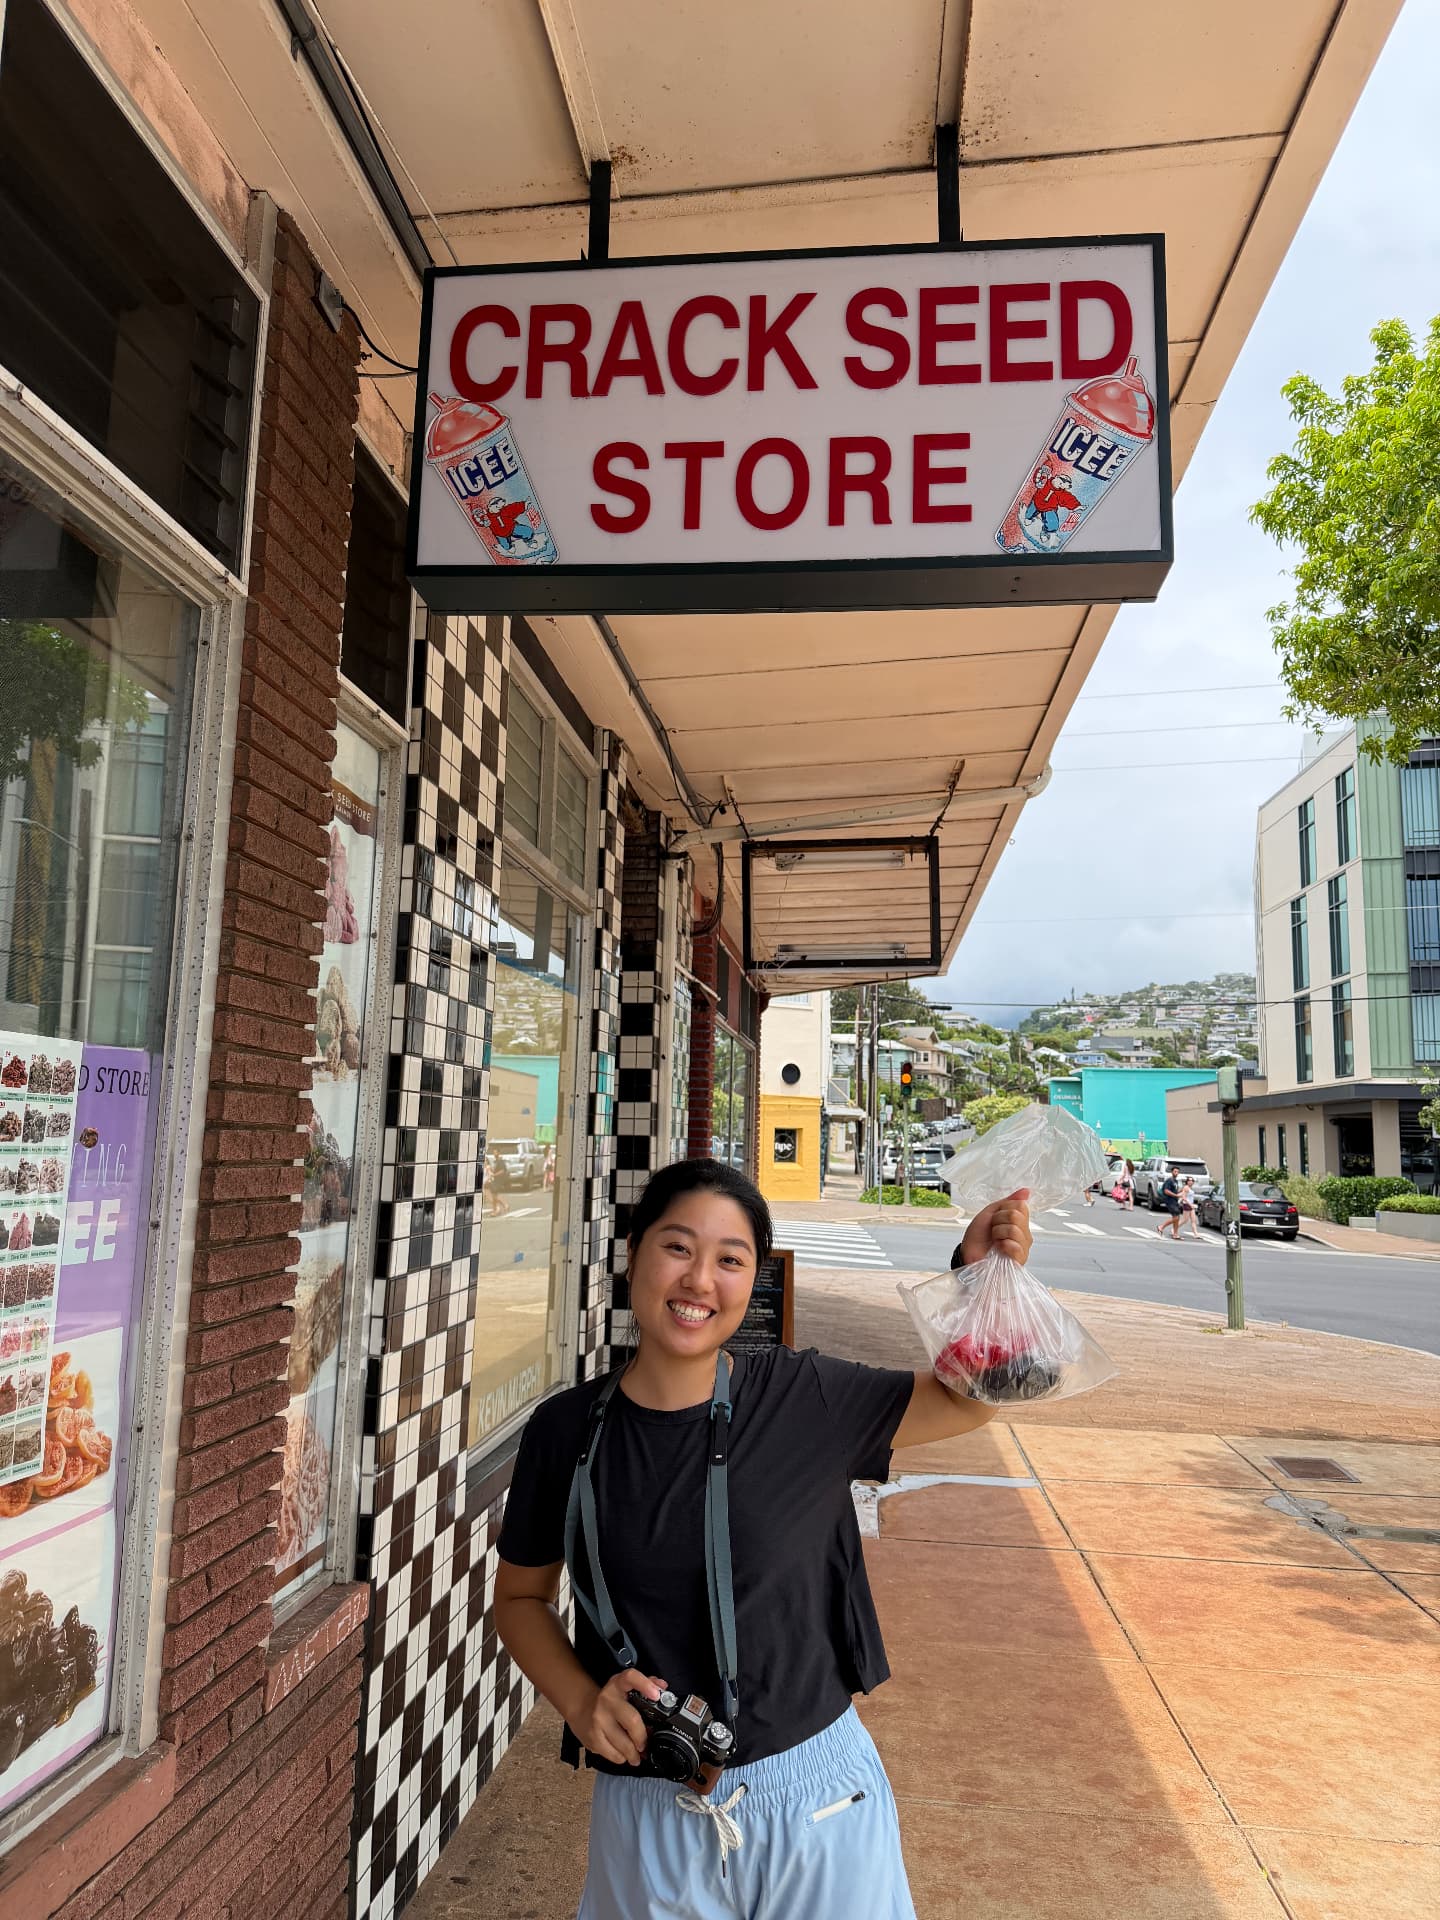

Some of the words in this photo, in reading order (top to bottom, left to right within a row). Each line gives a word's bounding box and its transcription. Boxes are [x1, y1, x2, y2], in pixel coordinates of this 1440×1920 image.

[449, 292, 819, 411] CRACK
[844, 280, 1134, 390] SEED
[446, 438, 518, 499] ICEE
[1050, 418, 1133, 481] ICEE
[589, 432, 973, 534] STORE
[352, 803, 372, 823] STORE
[95, 1066, 150, 1097] STORE
